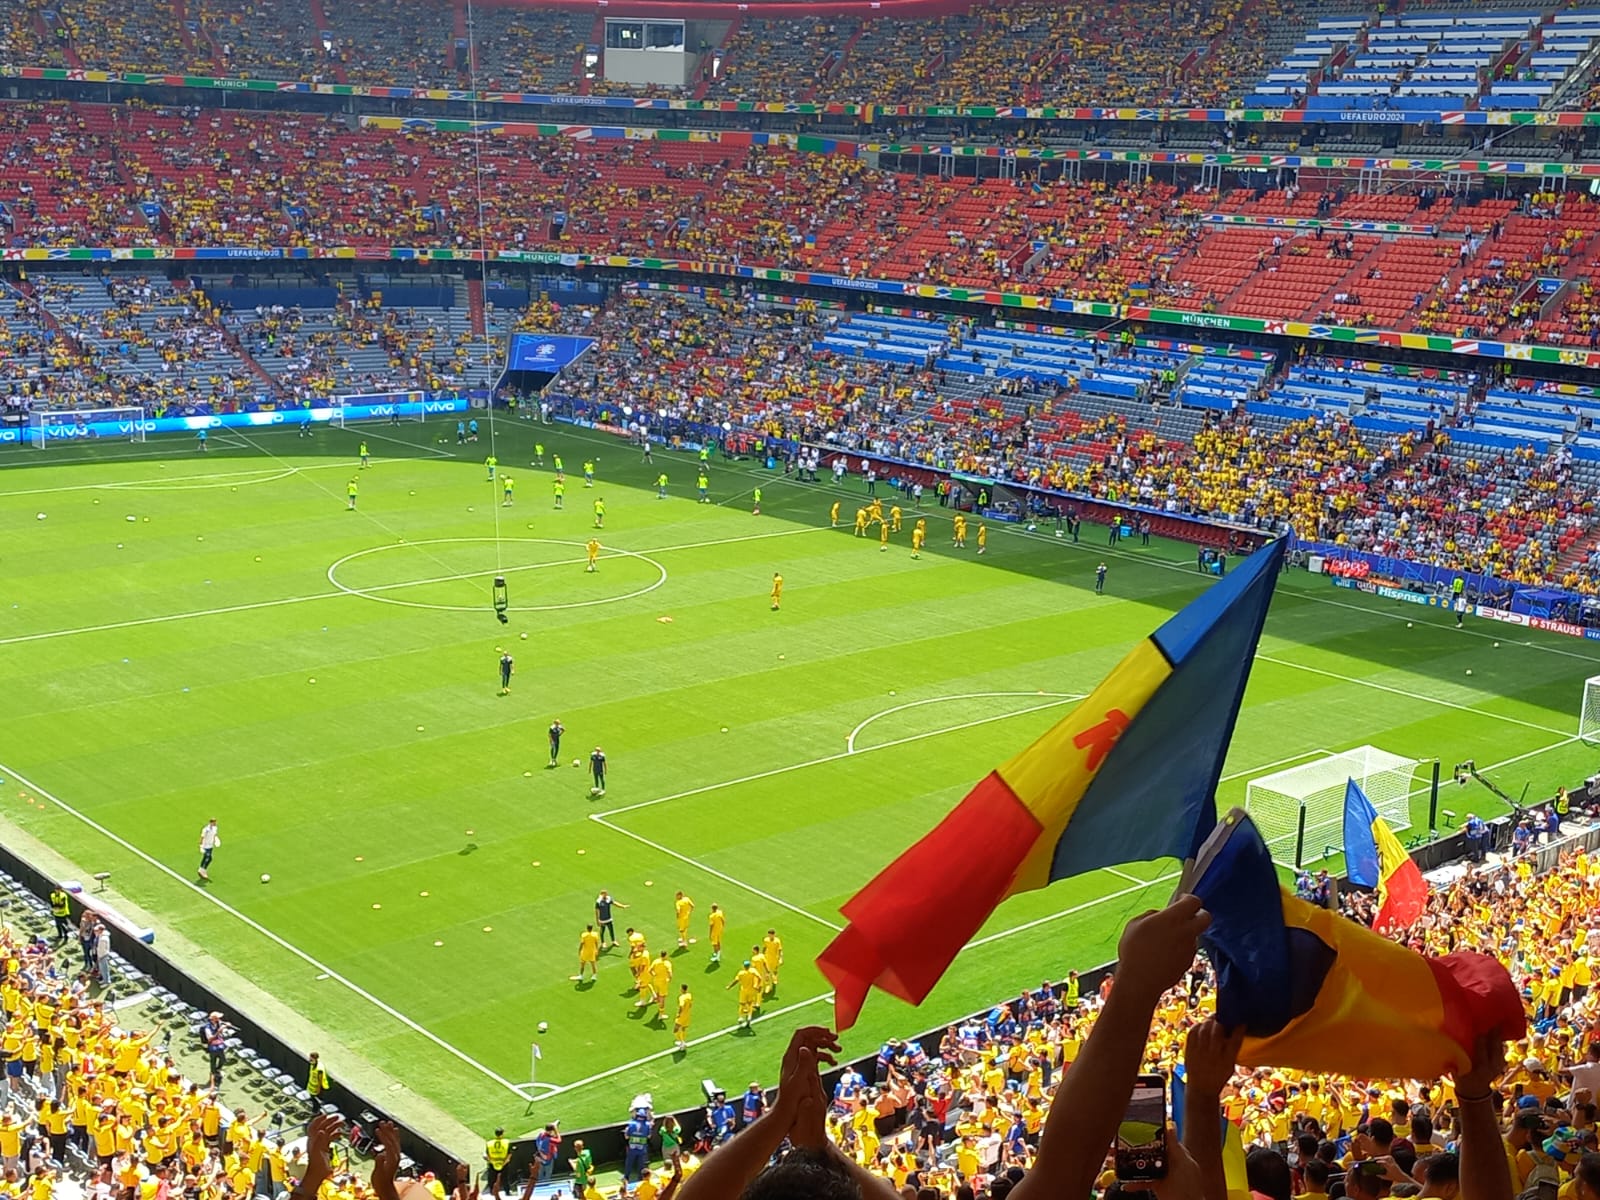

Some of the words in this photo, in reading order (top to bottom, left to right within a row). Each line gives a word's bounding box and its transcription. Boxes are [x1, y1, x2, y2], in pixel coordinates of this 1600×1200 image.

[425, 402, 455, 412] vivo
[118, 421, 157, 433] vivo
[1378, 586, 1425, 604] Hisense
[1483, 607, 1523, 624] BYD
[1541, 620, 1582, 636] STRAUSS
